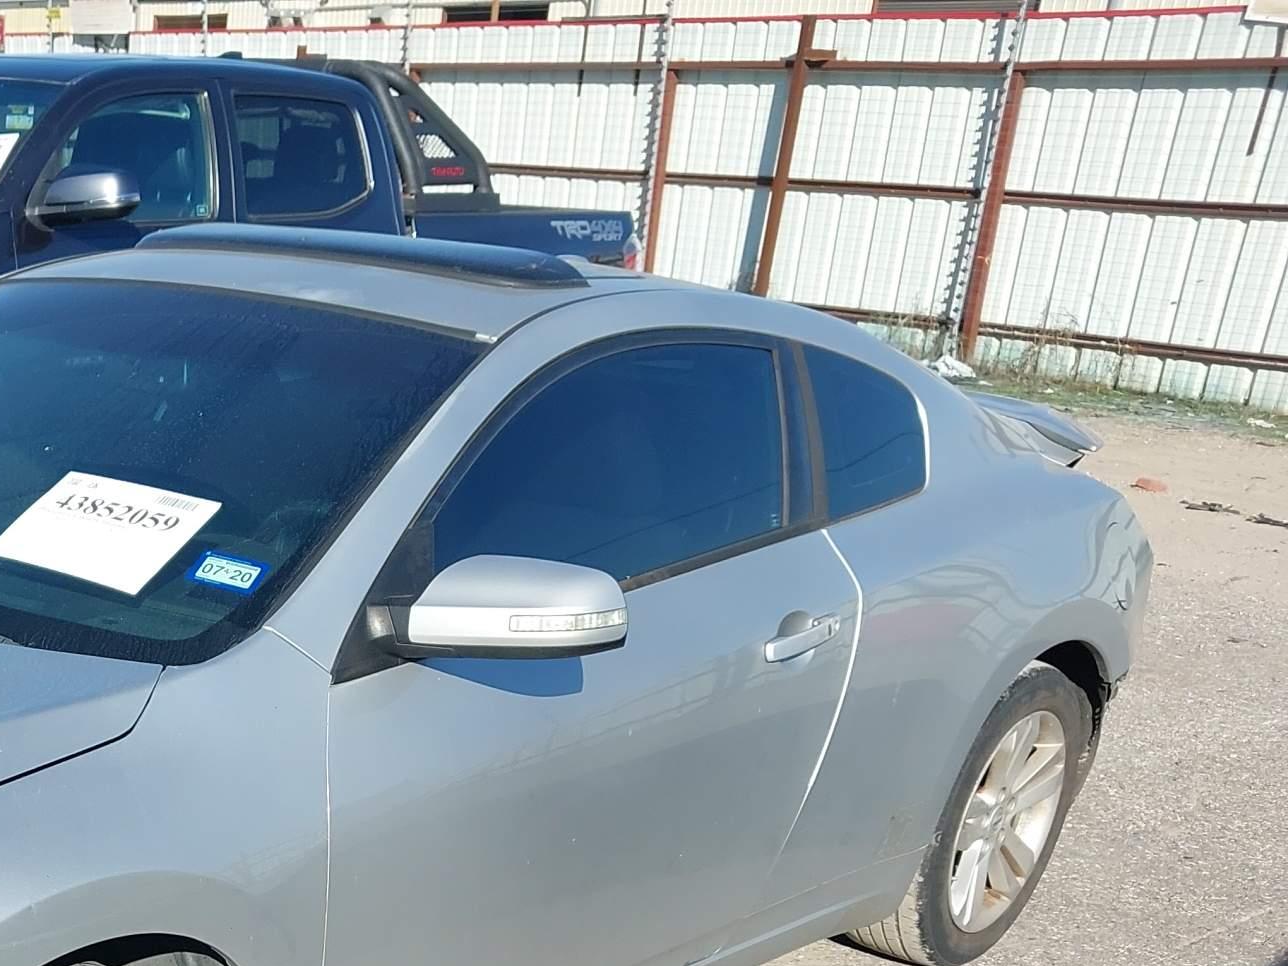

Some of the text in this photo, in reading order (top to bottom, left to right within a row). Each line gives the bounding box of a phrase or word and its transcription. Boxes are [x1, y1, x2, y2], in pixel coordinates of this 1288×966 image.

[550, 220, 592, 240] TRD
[56, 493, 180, 532] 43852059
[201, 563, 253, 583] 07 20
